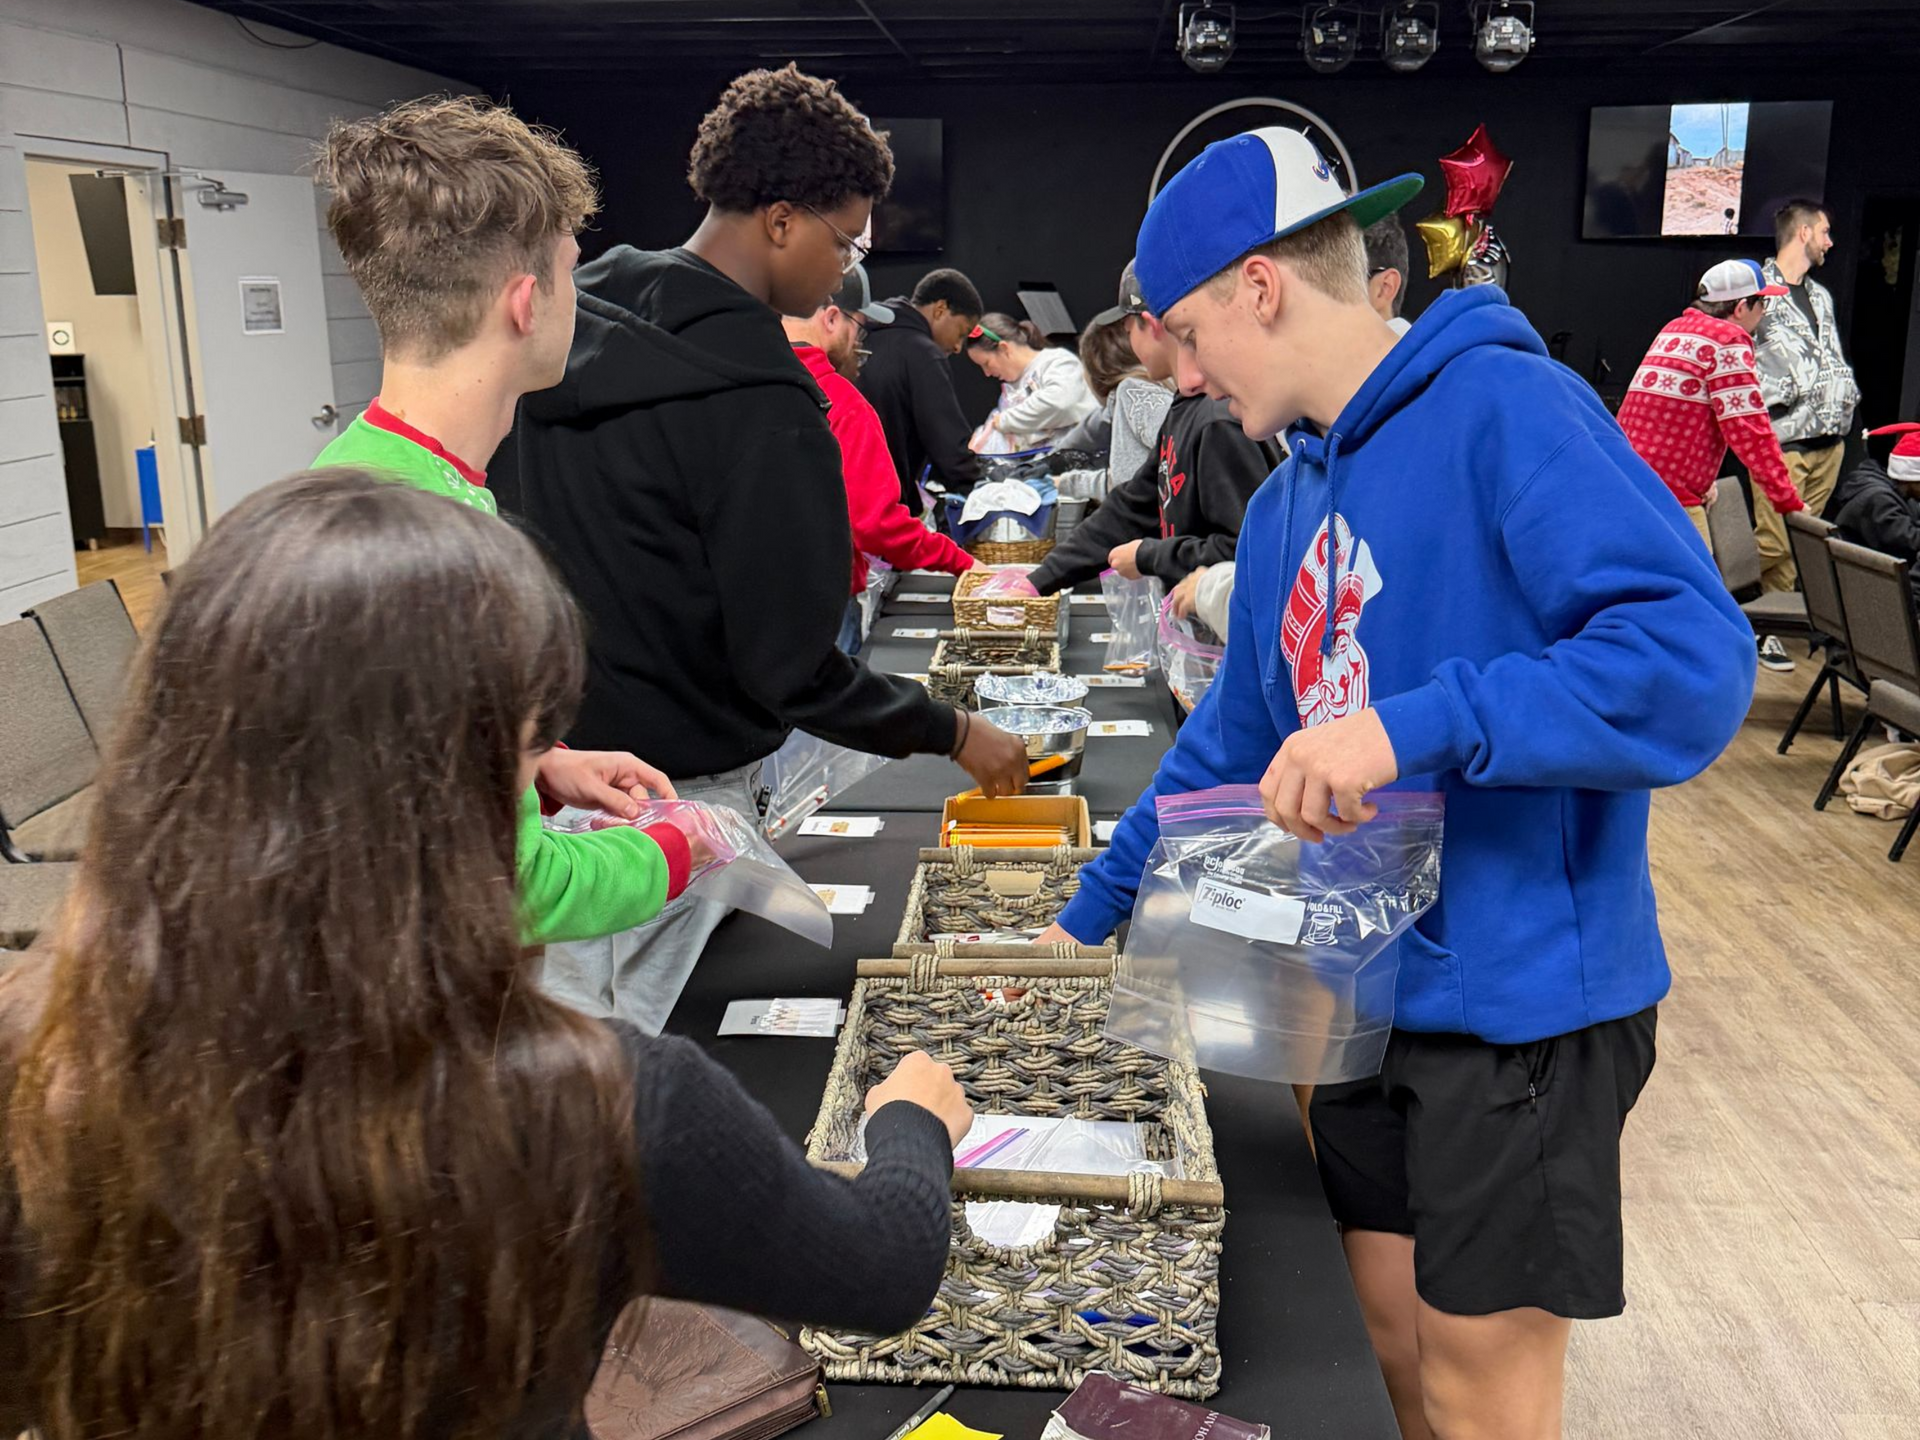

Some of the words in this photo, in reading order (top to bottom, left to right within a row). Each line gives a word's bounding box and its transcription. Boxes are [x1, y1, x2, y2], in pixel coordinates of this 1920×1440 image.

[1202, 886, 1243, 910] Ziploc
[1323, 904, 1329, 913] &
[1329, 904, 1344, 915] FILL
[1203, 1410, 1219, 1428] NIV
[1193, 1426, 1210, 1440] HO
